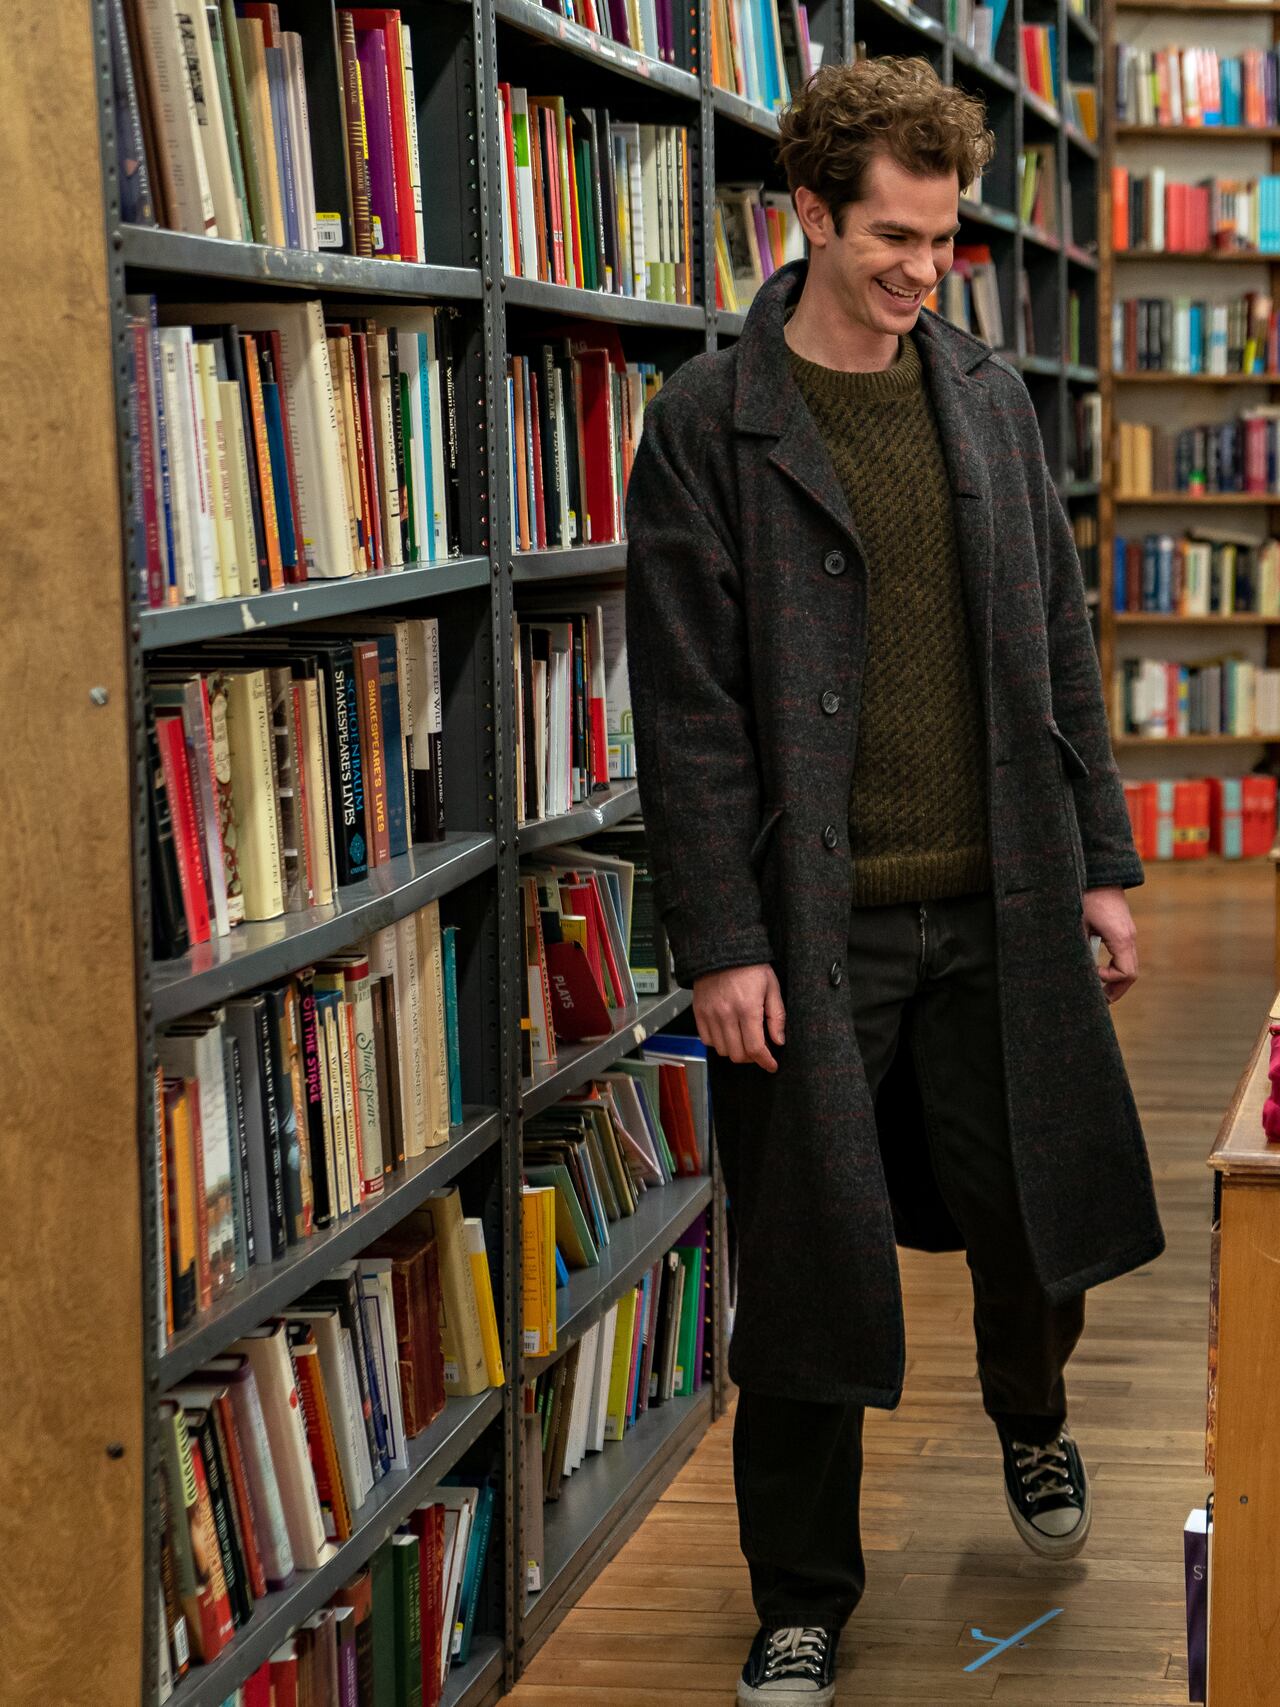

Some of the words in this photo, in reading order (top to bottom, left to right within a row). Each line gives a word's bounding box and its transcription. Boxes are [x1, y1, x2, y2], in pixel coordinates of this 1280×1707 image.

[354, 150, 366, 192] KERMODE
[320, 332, 338, 432] SHAKESPEARE
[546, 352, 554, 372] FOR
[444, 366, 454, 408] William
[548, 390, 558, 420] ACTOR
[446, 408, 456, 470] Shakespeare
[404, 630, 412, 698] CONTESTED
[430, 626, 440, 696] CONTESTED
[406, 702, 414, 730] WILL
[434, 698, 442, 728] WILL
[334, 670, 350, 782] SHAKESPEARE'S
[342, 784, 356, 826] LIVES
[346, 678, 364, 810] SCHOENBAUM
[366, 678, 382, 788] SHAKESPEARE'S
[376, 792, 386, 832] LIVES
[184, 772, 200, 852] SHAKESPEARE
[194, 854, 202, 886] WARS
[434, 942, 444, 1036] SHAKESPEARE'S
[540, 966, 552, 1028] CHARACTER
[552, 974, 576, 1010] PLAYS
[304, 1024, 318, 1054] THE
[408, 950, 420, 1044] SHAKESPEARE'S
[414, 1048, 422, 1106] SONNETS
[264, 1040, 272, 1072] YEAR
[330, 1056, 338, 1086] What
[342, 1050, 350, 1080] What
[438, 1038, 446, 1096] SONNETS
[266, 1078, 272, 1092] OF
[306, 1058, 322, 1104] STAGE
[332, 1086, 340, 1114] Blest
[344, 1080, 354, 1108] Blest
[356, 1032, 378, 1128] Shakespeare
[238, 1106, 244, 1120] OF
[268, 1096, 276, 1134] LEAR
[346, 1108, 356, 1150] Genius?
[240, 1124, 248, 1158] LEAR
[334, 1114, 344, 1156] Genius?
[274, 1178, 282, 1216] SHAPIRO
